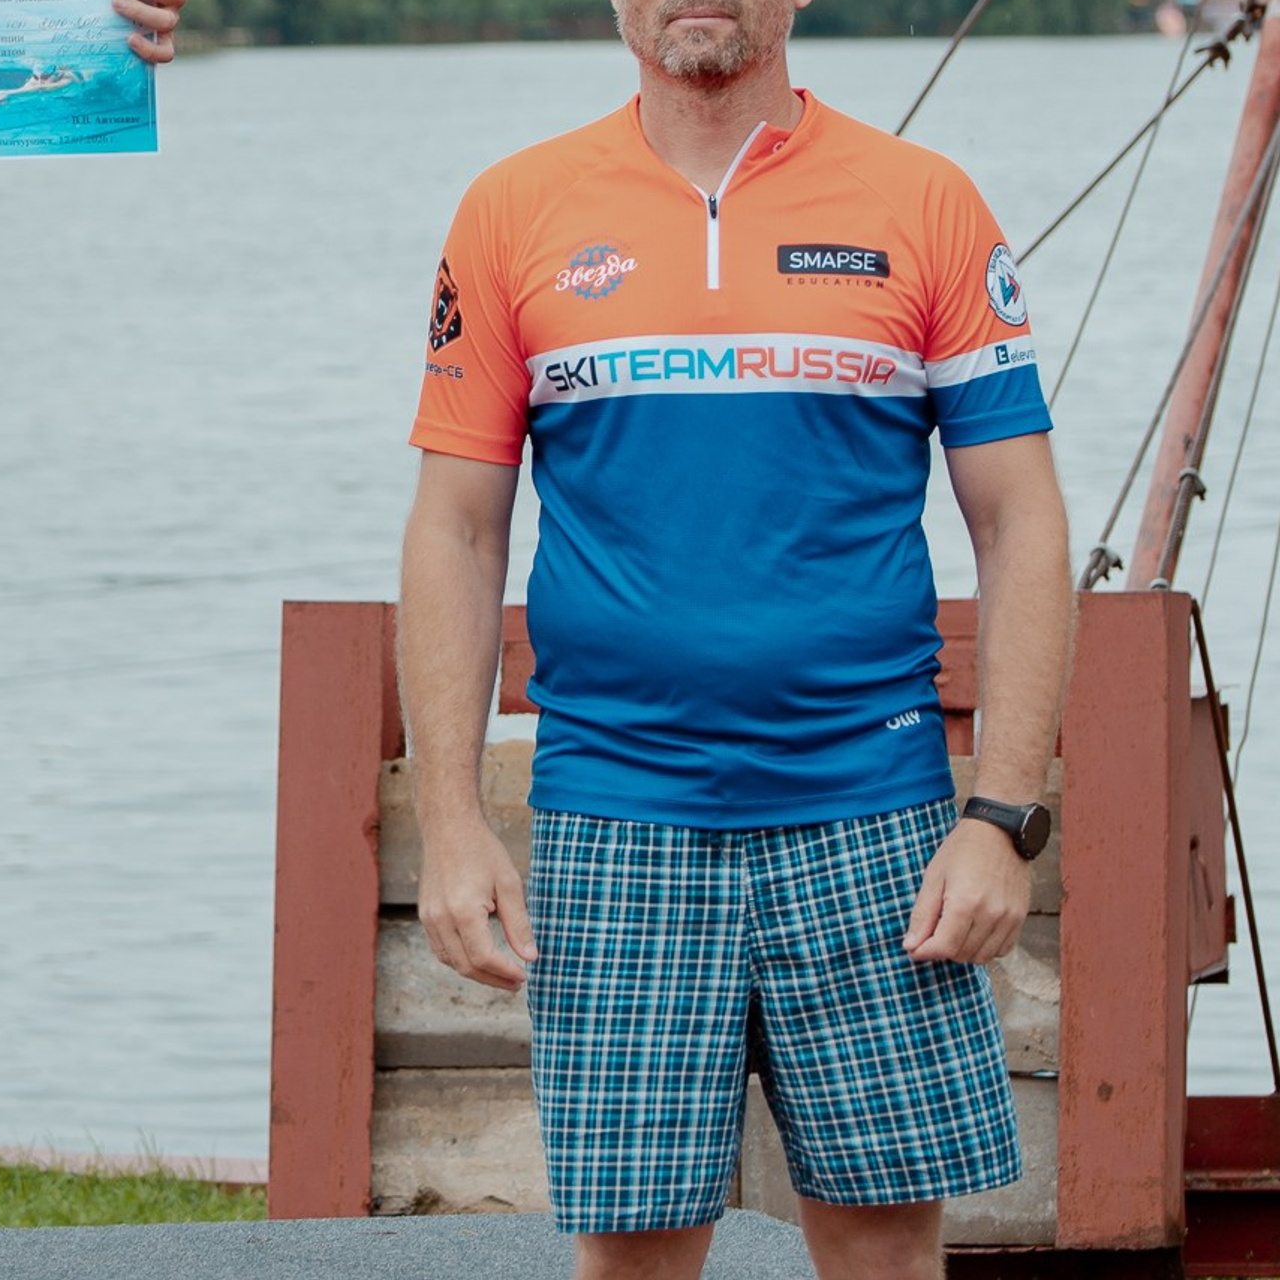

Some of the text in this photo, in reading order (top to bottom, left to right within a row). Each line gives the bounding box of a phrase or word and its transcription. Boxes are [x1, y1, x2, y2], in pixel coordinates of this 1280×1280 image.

[555, 255, 637, 291] Звезда
[789, 251, 877, 271] SMAPSE
[787, 277, 884, 288] EDUCATION
[545, 346, 897, 392] SKITEAMRUSSIA
